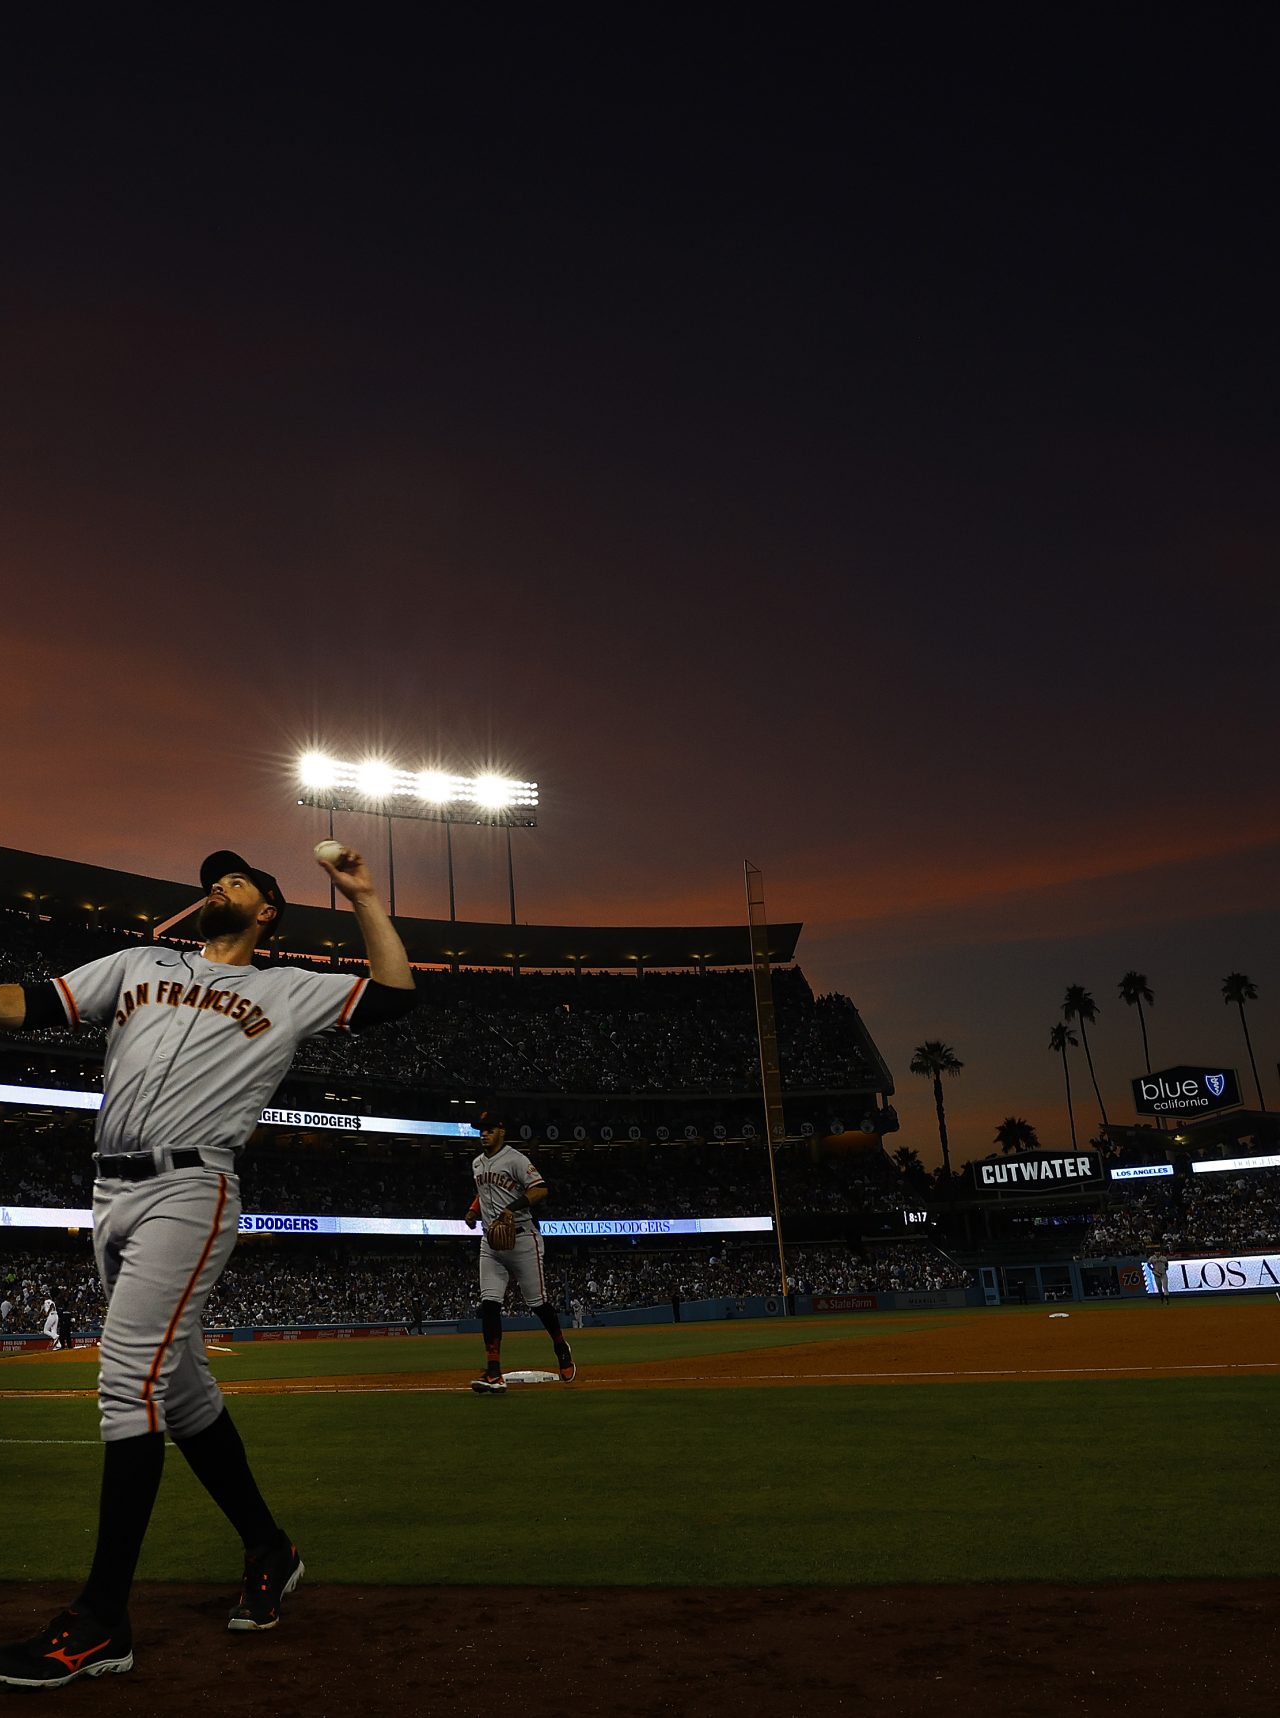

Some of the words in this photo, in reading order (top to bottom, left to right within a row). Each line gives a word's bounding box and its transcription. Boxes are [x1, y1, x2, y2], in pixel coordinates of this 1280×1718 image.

[156, 979, 272, 1040] FRANCISCO
[1141, 1077, 1199, 1101] blue
[1153, 1096, 1210, 1111] california
[259, 1110, 302, 1125] GELES
[304, 1113, 362, 1129] DODGERS
[981, 1156, 1093, 1185] CUTWATER
[1133, 1167, 1168, 1176] ANGELES
[255, 1217, 319, 1231] DODGERS
[909, 1212, 927, 1222] 8:17
[541, 1222, 558, 1235] OS
[560, 1221, 613, 1235] ANGELES
[614, 1220, 671, 1234] DODGERS
[1123, 1271, 1140, 1287] 76
[1179, 1260, 1247, 1290] LOS
